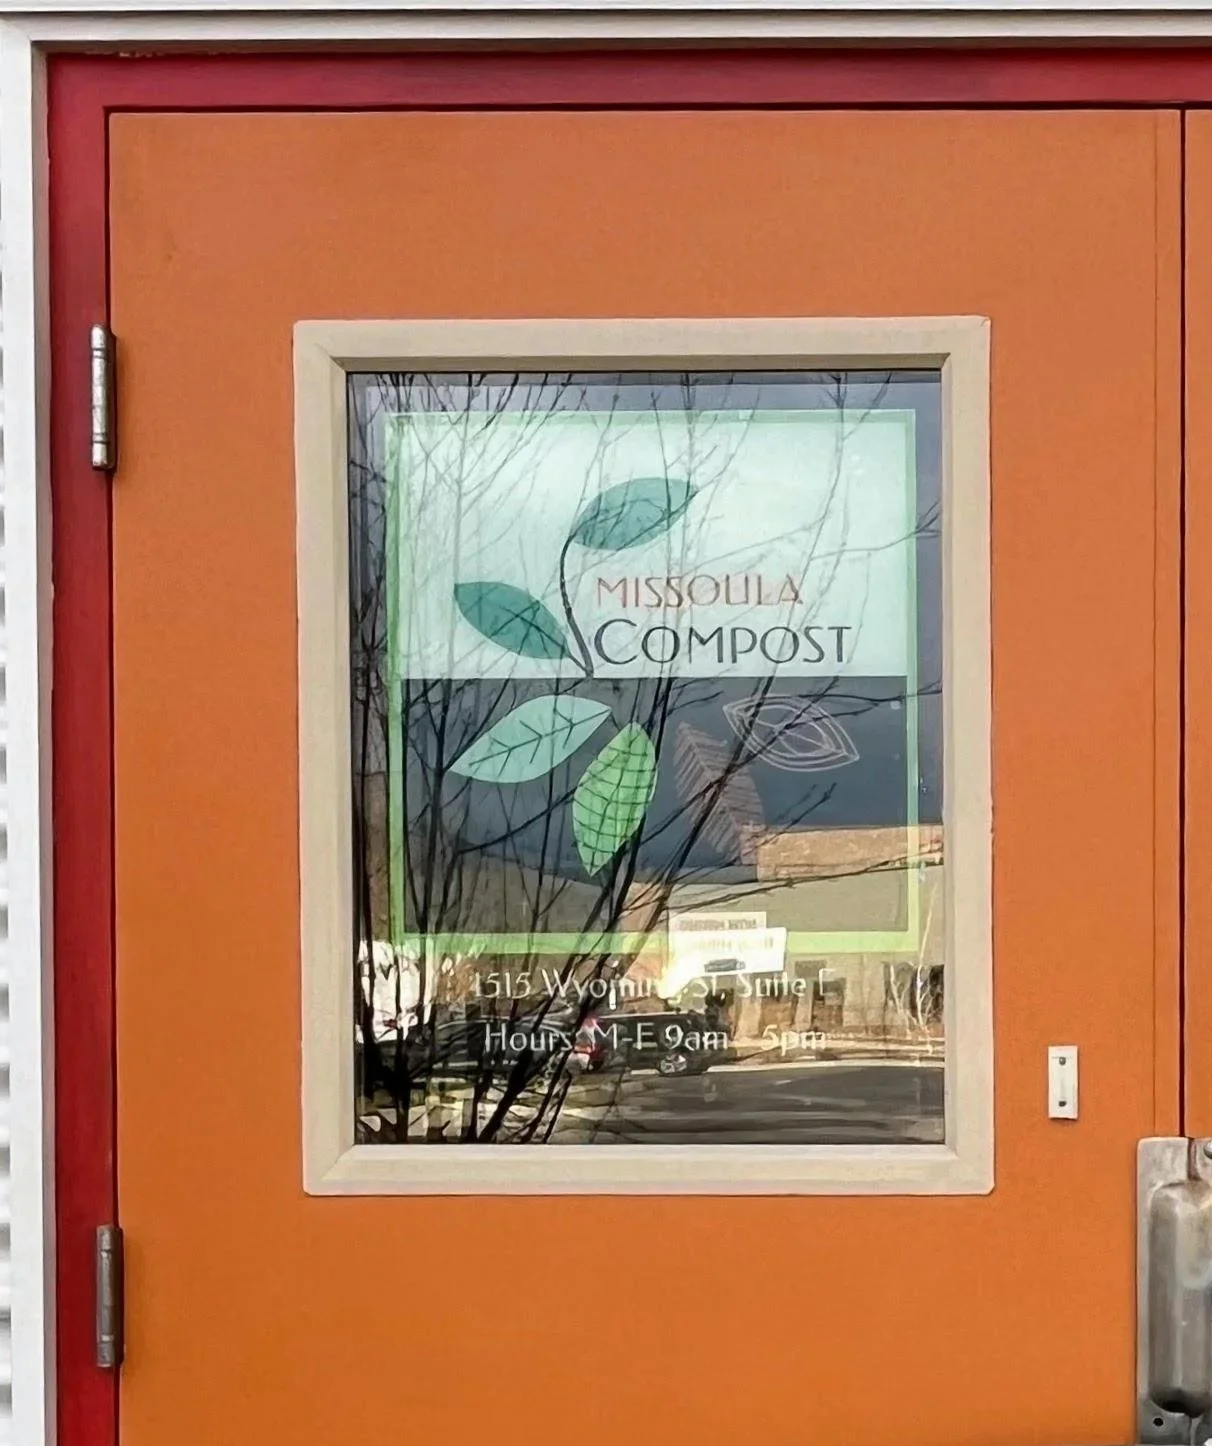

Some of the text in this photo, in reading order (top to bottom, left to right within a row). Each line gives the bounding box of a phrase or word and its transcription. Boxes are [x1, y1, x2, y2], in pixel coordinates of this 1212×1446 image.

[597, 573, 804, 609] MISSOULA
[593, 617, 853, 666] COMPOST
[474, 971, 532, 999] 1515
[736, 972, 807, 998] Suite
[665, 1023, 730, 1052] 9am
[761, 1023, 827, 1057] 5pm
